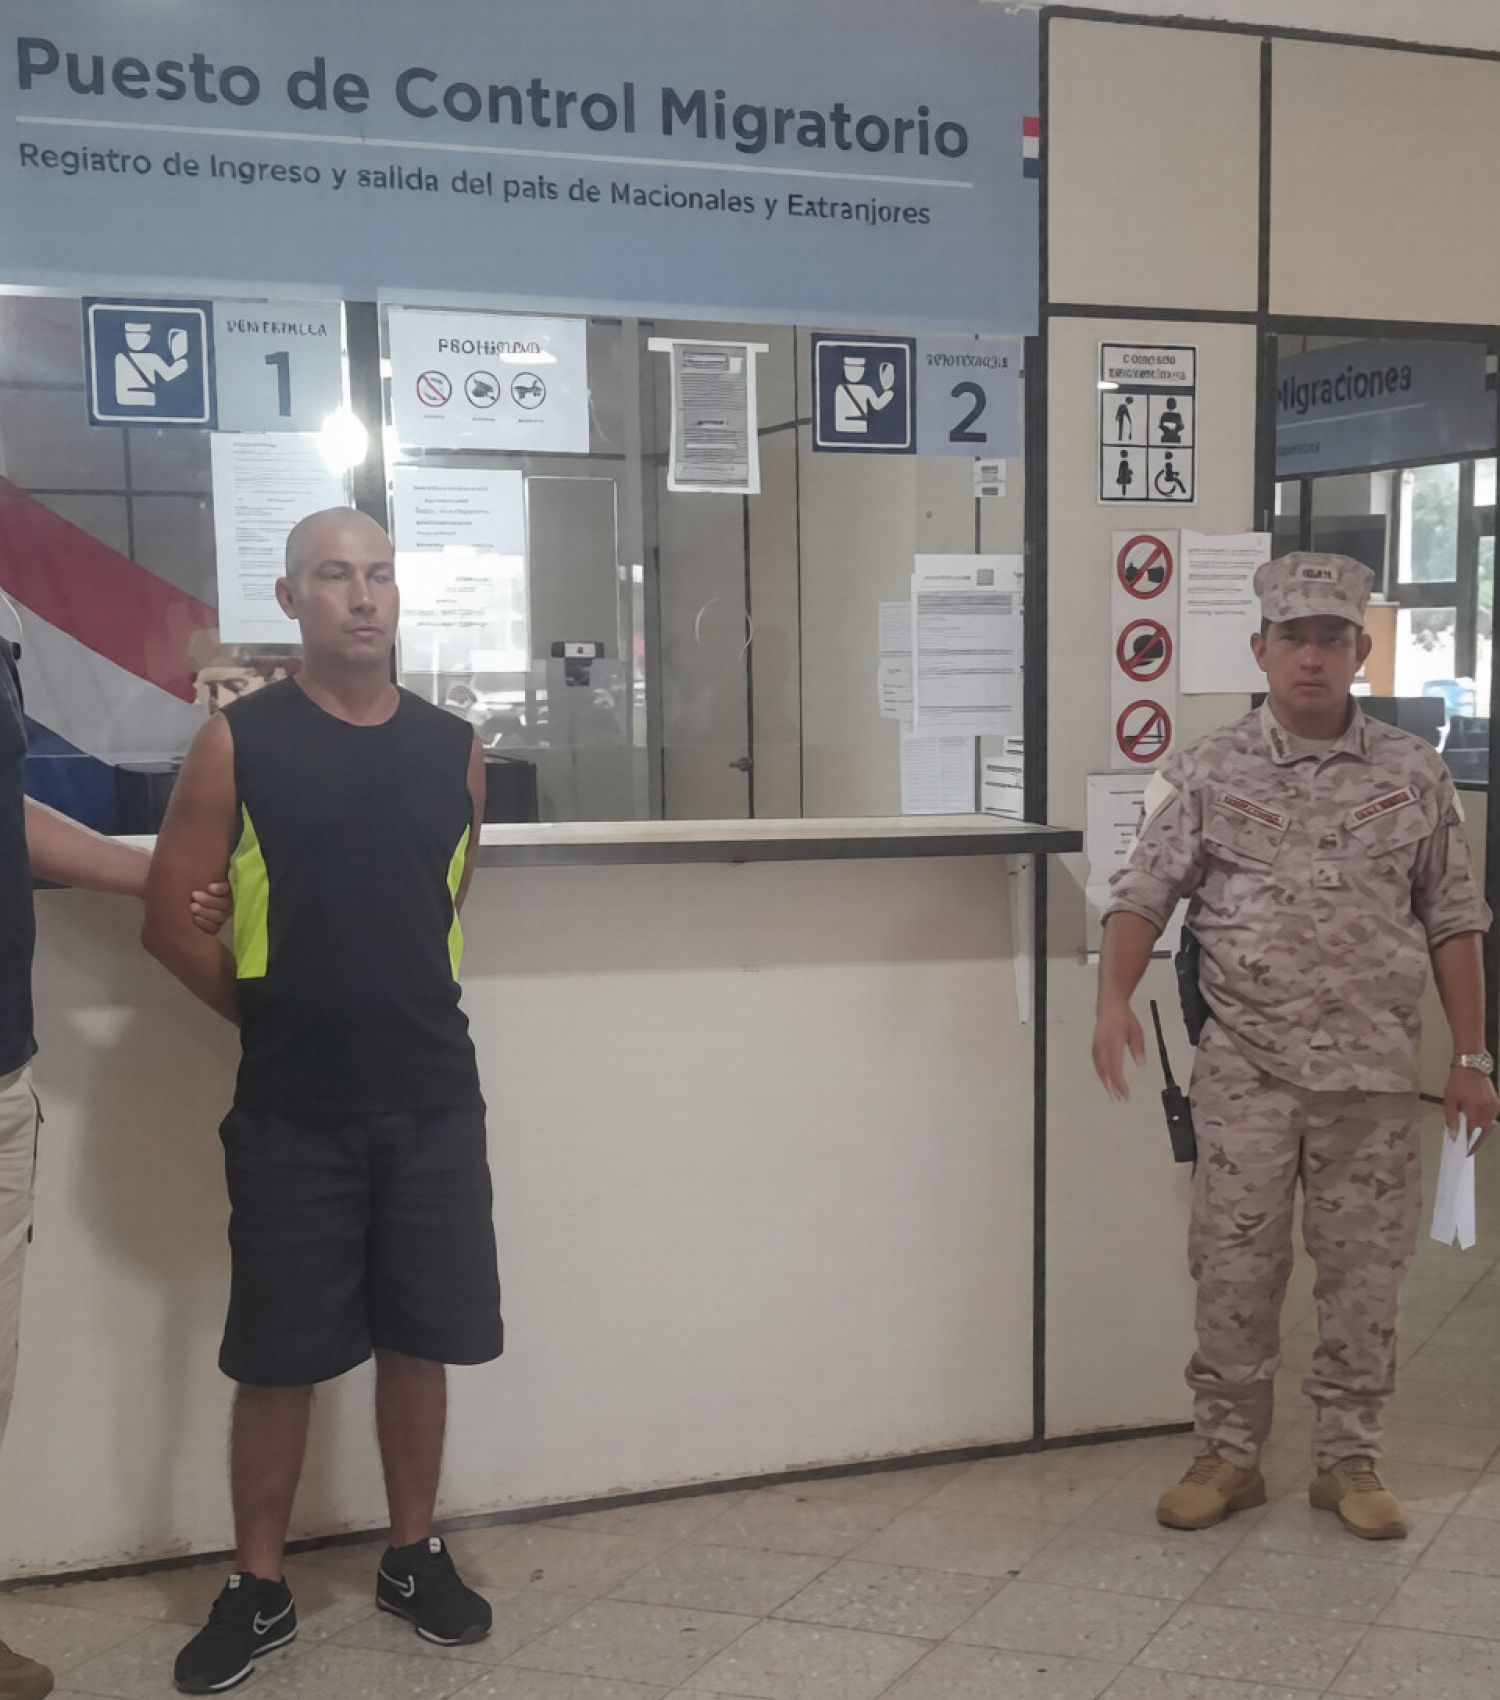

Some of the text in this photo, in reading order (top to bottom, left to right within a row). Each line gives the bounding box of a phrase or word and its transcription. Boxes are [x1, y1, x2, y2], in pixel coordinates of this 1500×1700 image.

[16, 36, 970, 159] Puesto de Control Migratorio
[162, 151, 200, 176] de
[210, 153, 321, 186] Ingreso
[331, 167, 347, 190] y
[451, 169, 493, 197] del
[568, 177, 601, 203] de
[764, 197, 778, 221] y
[264, 351, 291, 417] 1
[949, 381, 987, 443] 2
